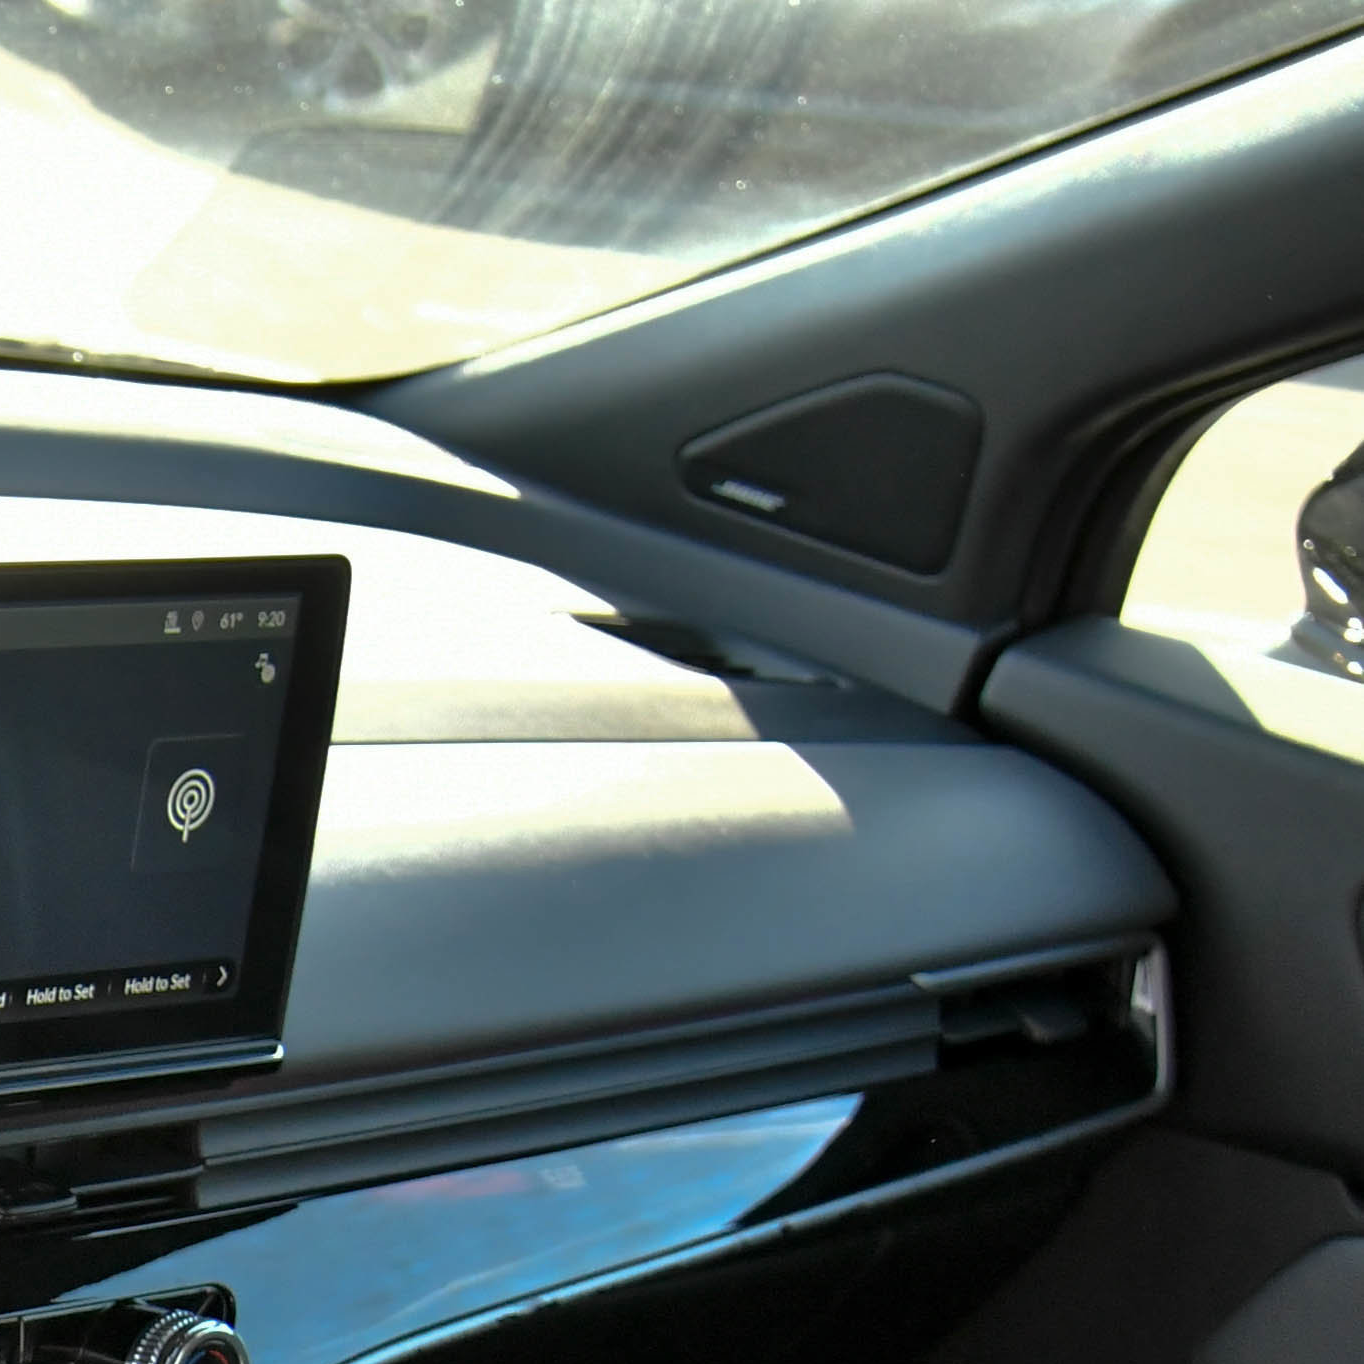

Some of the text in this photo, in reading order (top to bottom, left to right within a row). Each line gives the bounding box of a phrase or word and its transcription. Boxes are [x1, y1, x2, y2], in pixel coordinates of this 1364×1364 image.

[26, 983, 96, 1006] Hold to Set
[124, 973, 191, 996] Hold to Set
